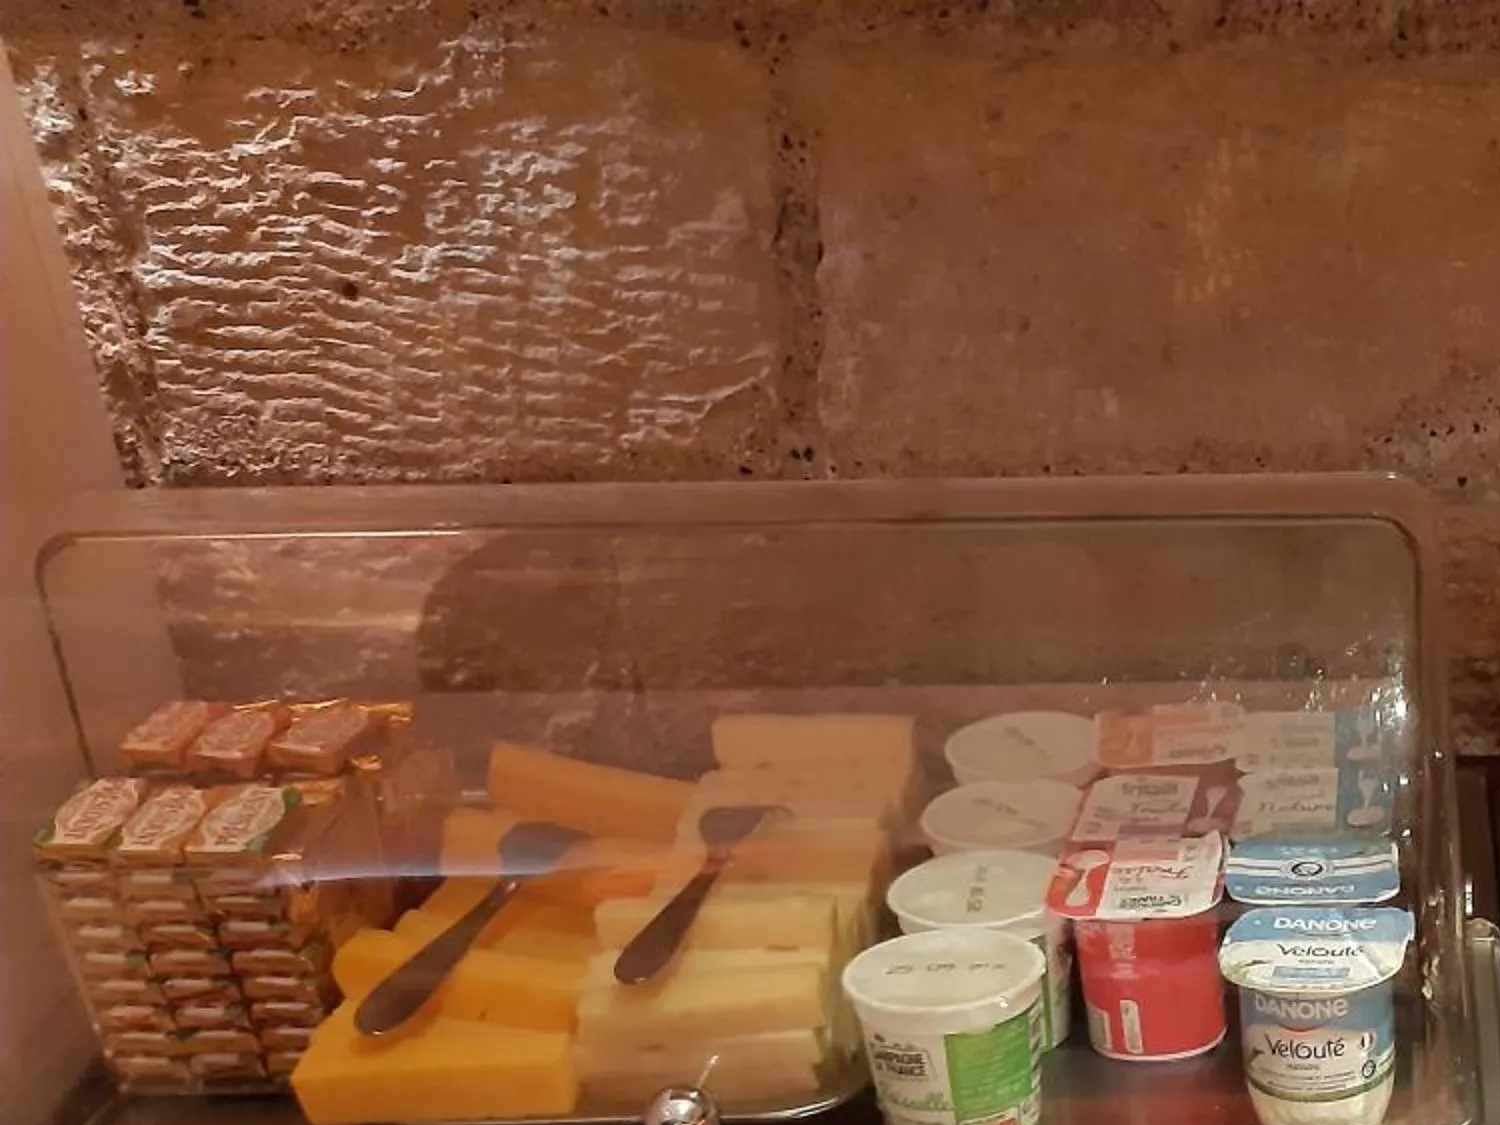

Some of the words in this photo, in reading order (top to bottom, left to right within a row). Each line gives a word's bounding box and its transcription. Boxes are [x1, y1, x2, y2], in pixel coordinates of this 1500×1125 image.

[1273, 916, 1377, 931] DANONE
[1255, 993, 1350, 1019] DANONE
[1263, 1032, 1346, 1059] Velouté
